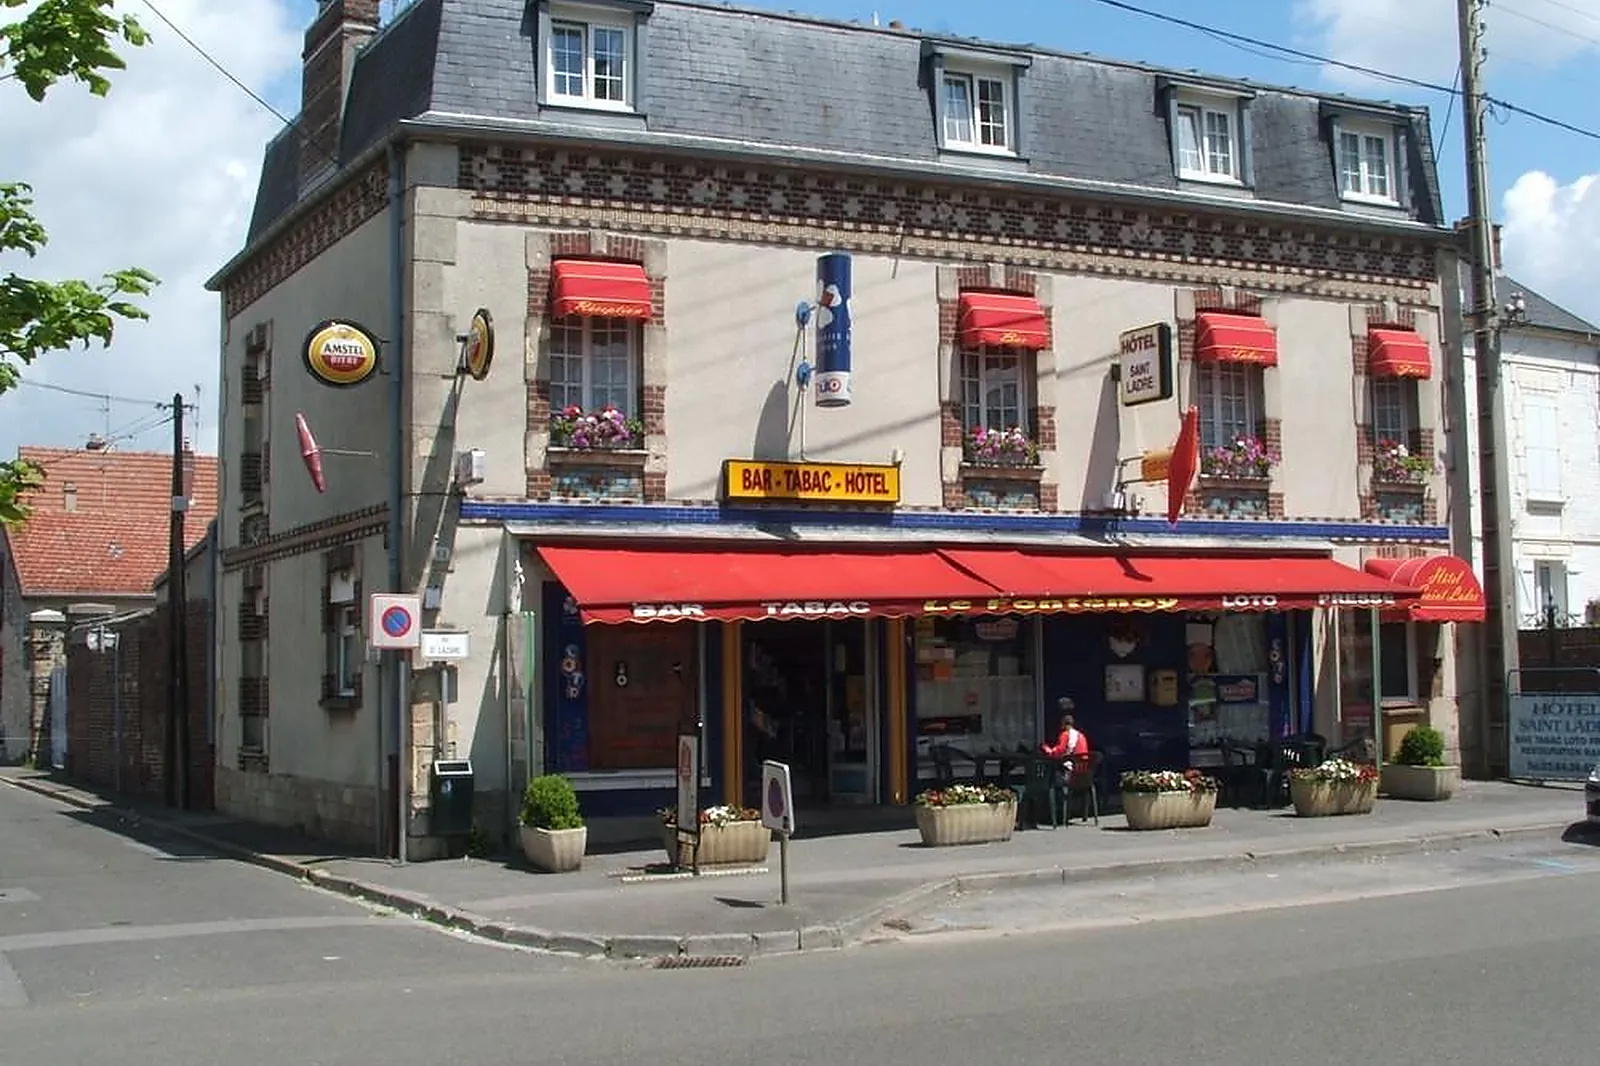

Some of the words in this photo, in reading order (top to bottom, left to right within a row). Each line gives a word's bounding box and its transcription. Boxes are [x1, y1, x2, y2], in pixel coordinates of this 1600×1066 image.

[324, 342, 364, 356] AMSTEL
[1129, 361, 1151, 378] SAINT
[742, 469, 771, 491] BAR
[784, 470, 832, 493] TABAC
[845, 468, 890, 495] HÔTEL
[633, 603, 706, 617] BAR
[761, 601, 871, 615] TABAC
[1222, 594, 1278, 607] LOTO
[1318, 593, 1396, 605] PRESSE
[1519, 718, 1562, 733] SAINT
